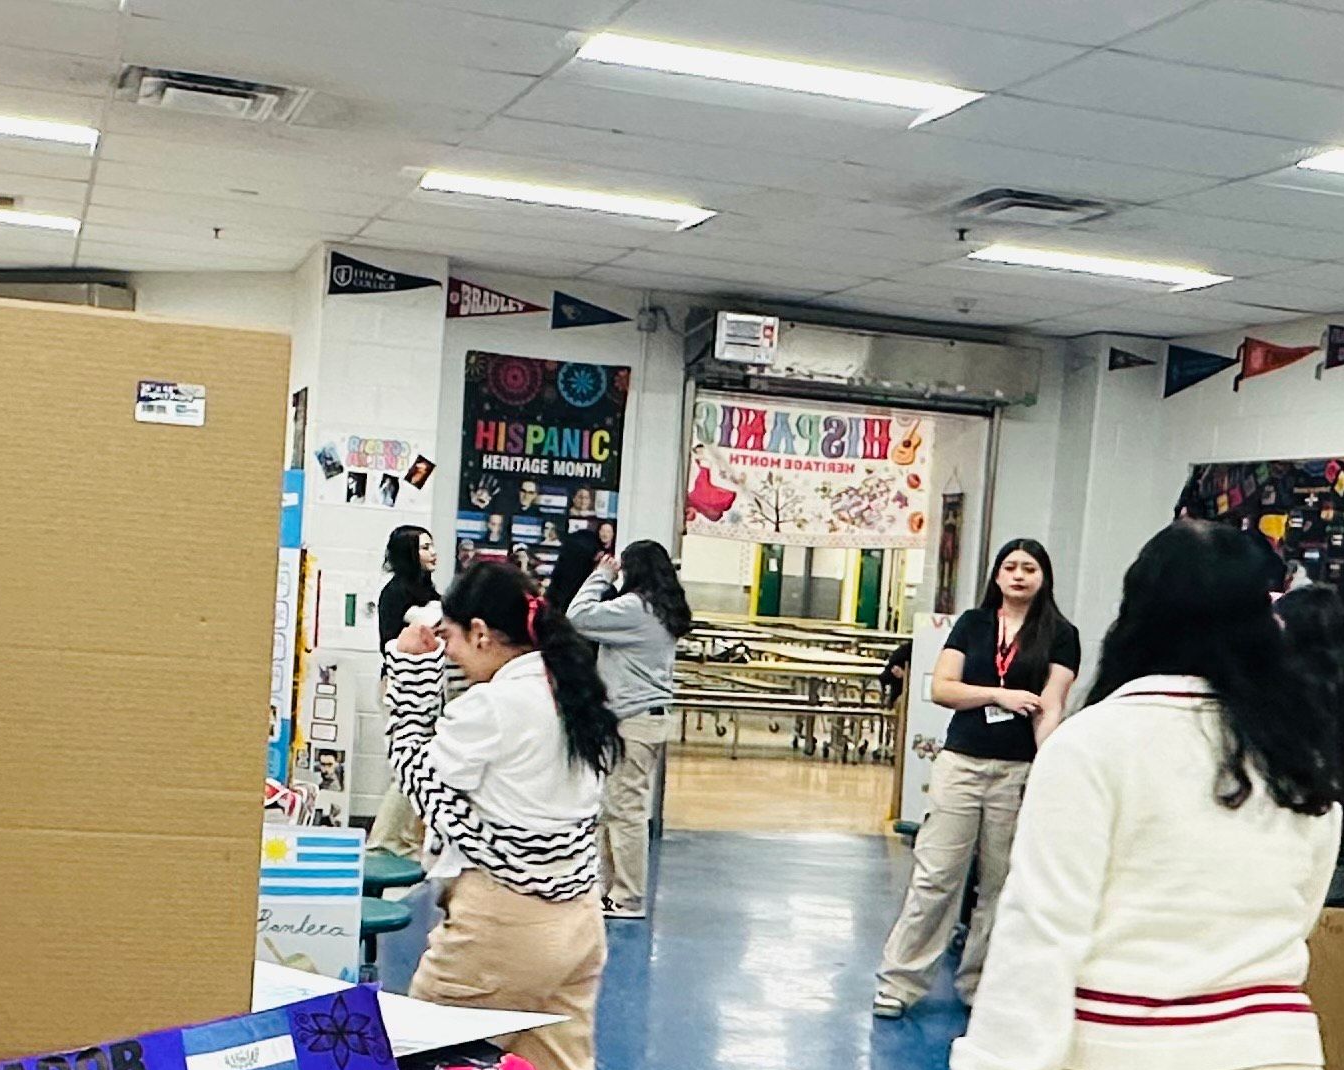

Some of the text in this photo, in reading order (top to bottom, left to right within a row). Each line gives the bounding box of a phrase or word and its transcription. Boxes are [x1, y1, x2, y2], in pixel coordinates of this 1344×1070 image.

[354, 269, 396, 281] ITHACA
[460, 284, 526, 315] BRADLEY
[475, 420, 611, 461] HISPANIC
[482, 454, 603, 479] HERITAGE MONTH
